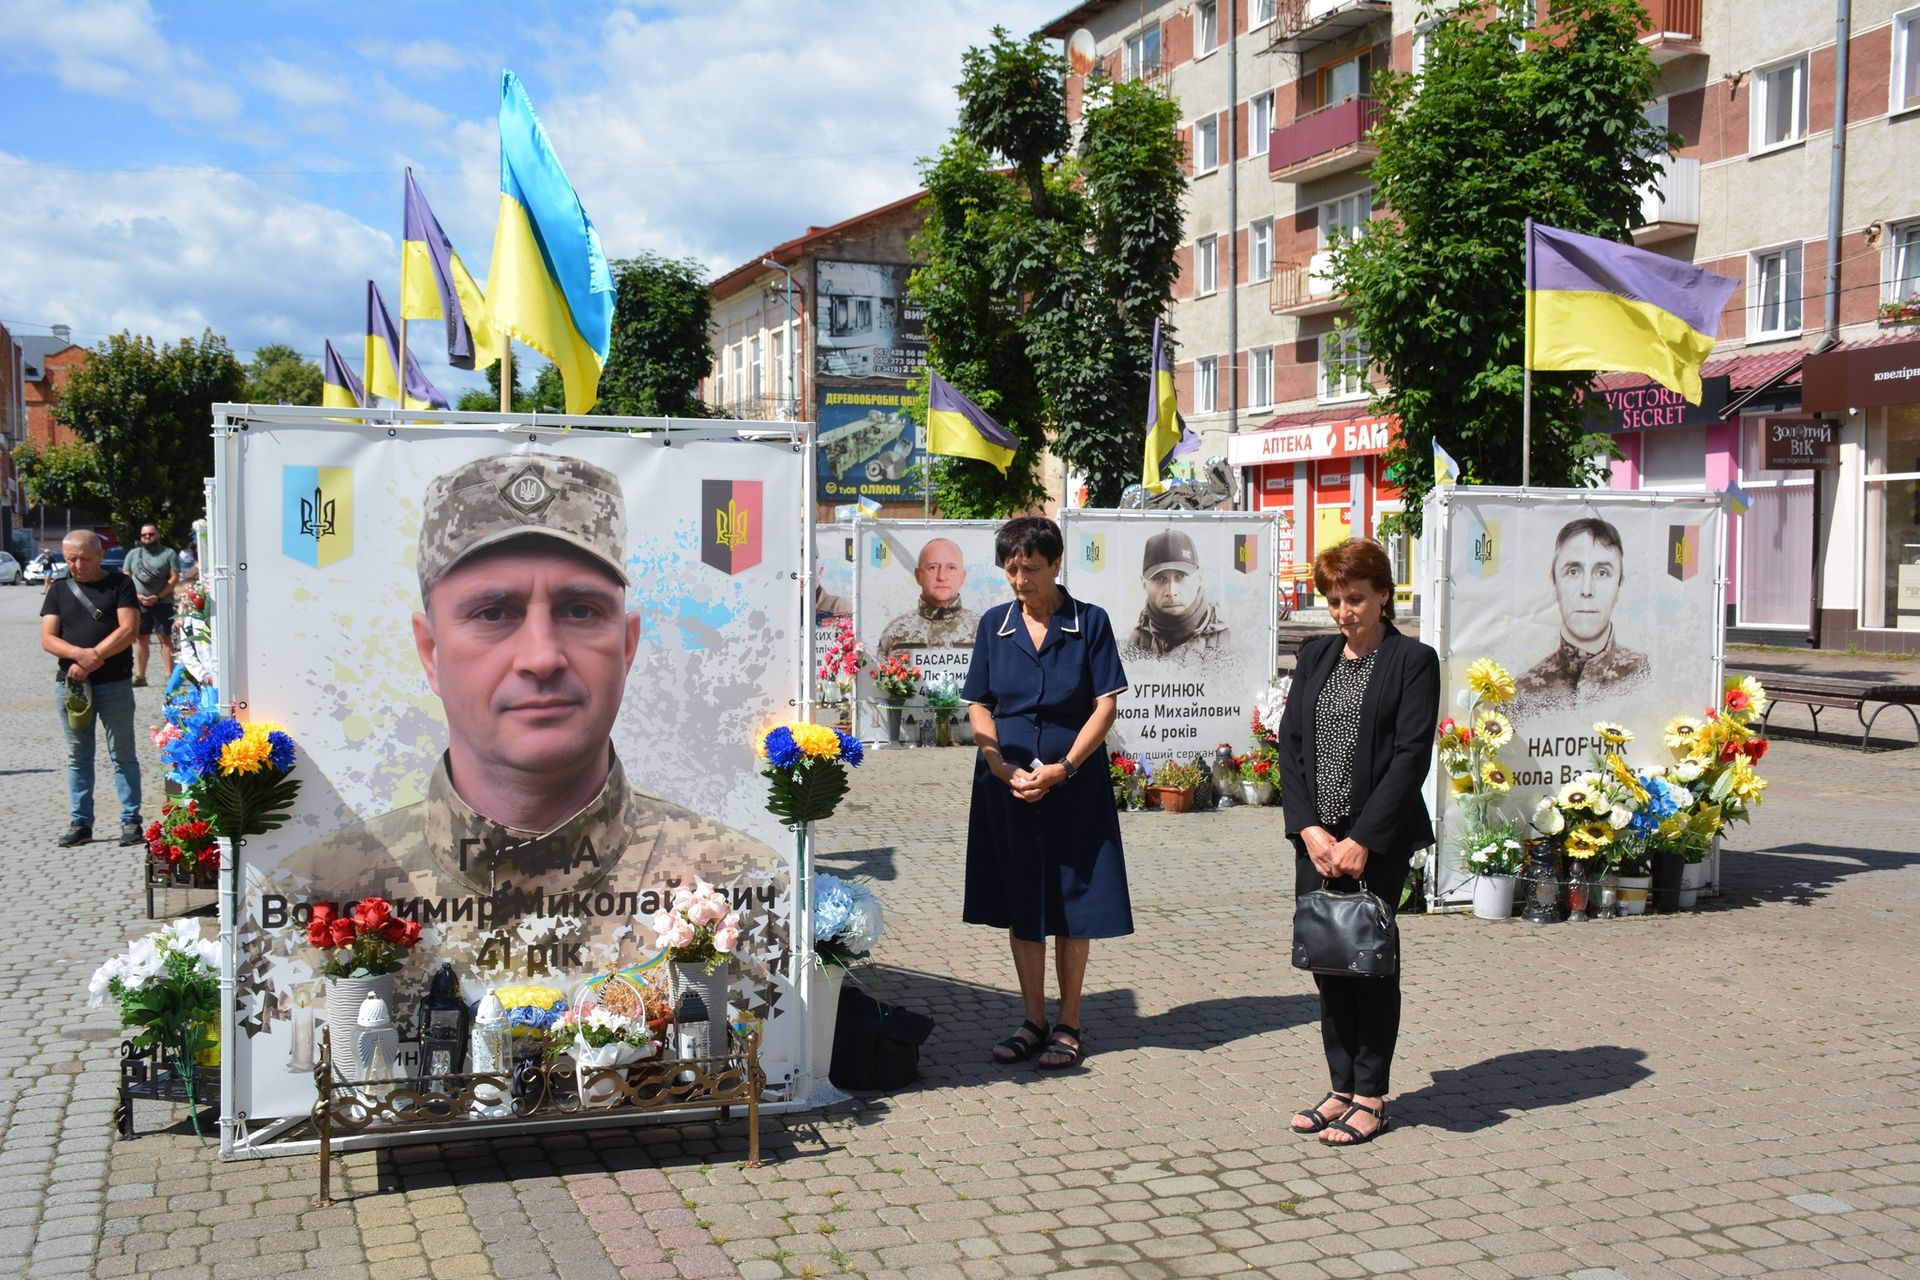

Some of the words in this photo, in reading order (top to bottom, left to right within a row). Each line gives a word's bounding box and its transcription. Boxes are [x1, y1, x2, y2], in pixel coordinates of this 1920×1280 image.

[1874, 366, 1920, 380] ювелірн
[825, 392, 900, 406] ДЕРЕВООБРОБНЕ
[1622, 405, 1686, 429] SECRET
[1262, 433, 1313, 454] АПТЕКА
[1343, 422, 1389, 452] БАМ
[860, 484, 901, 495] ОЛМОН
[915, 653, 969, 666] БАСАРАБ
[1134, 683, 1205, 698] УГРИНЮК
[1117, 708, 1150, 720] кола
[1154, 702, 1241, 718] Михайлович
[1140, 724, 1157, 739] 46
[1161, 724, 1198, 742] років
[1512, 768, 1553, 786] кола
[514, 878, 775, 919] Миколайвич
[476, 935, 511, 970] 41
[527, 939, 583, 977] рік
